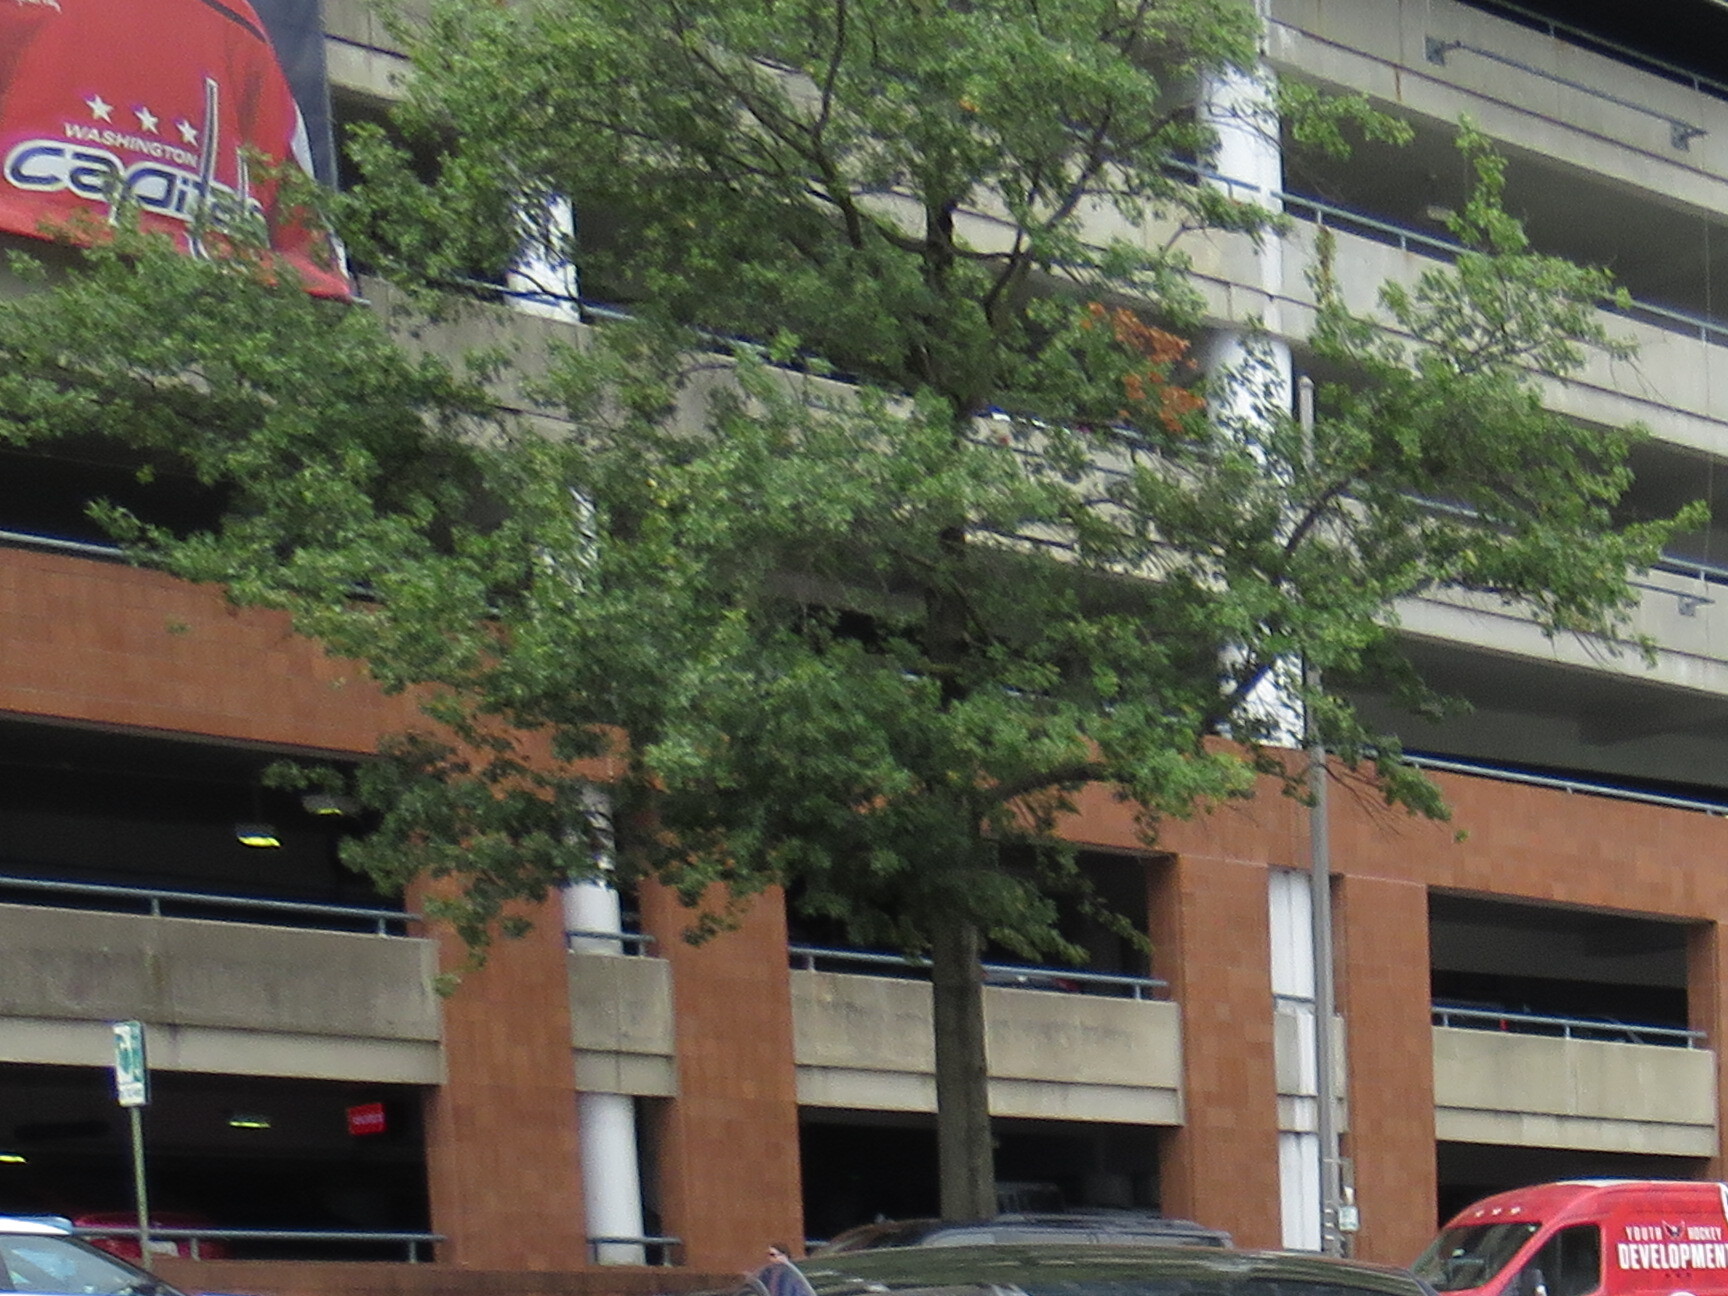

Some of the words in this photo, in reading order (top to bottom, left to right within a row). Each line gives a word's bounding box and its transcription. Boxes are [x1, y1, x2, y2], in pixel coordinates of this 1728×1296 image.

[64, 122, 199, 168] WASHINGTON
[1625, 1225, 1663, 1241] YOUTH
[1687, 1226, 1722, 1241] HOCKEY
